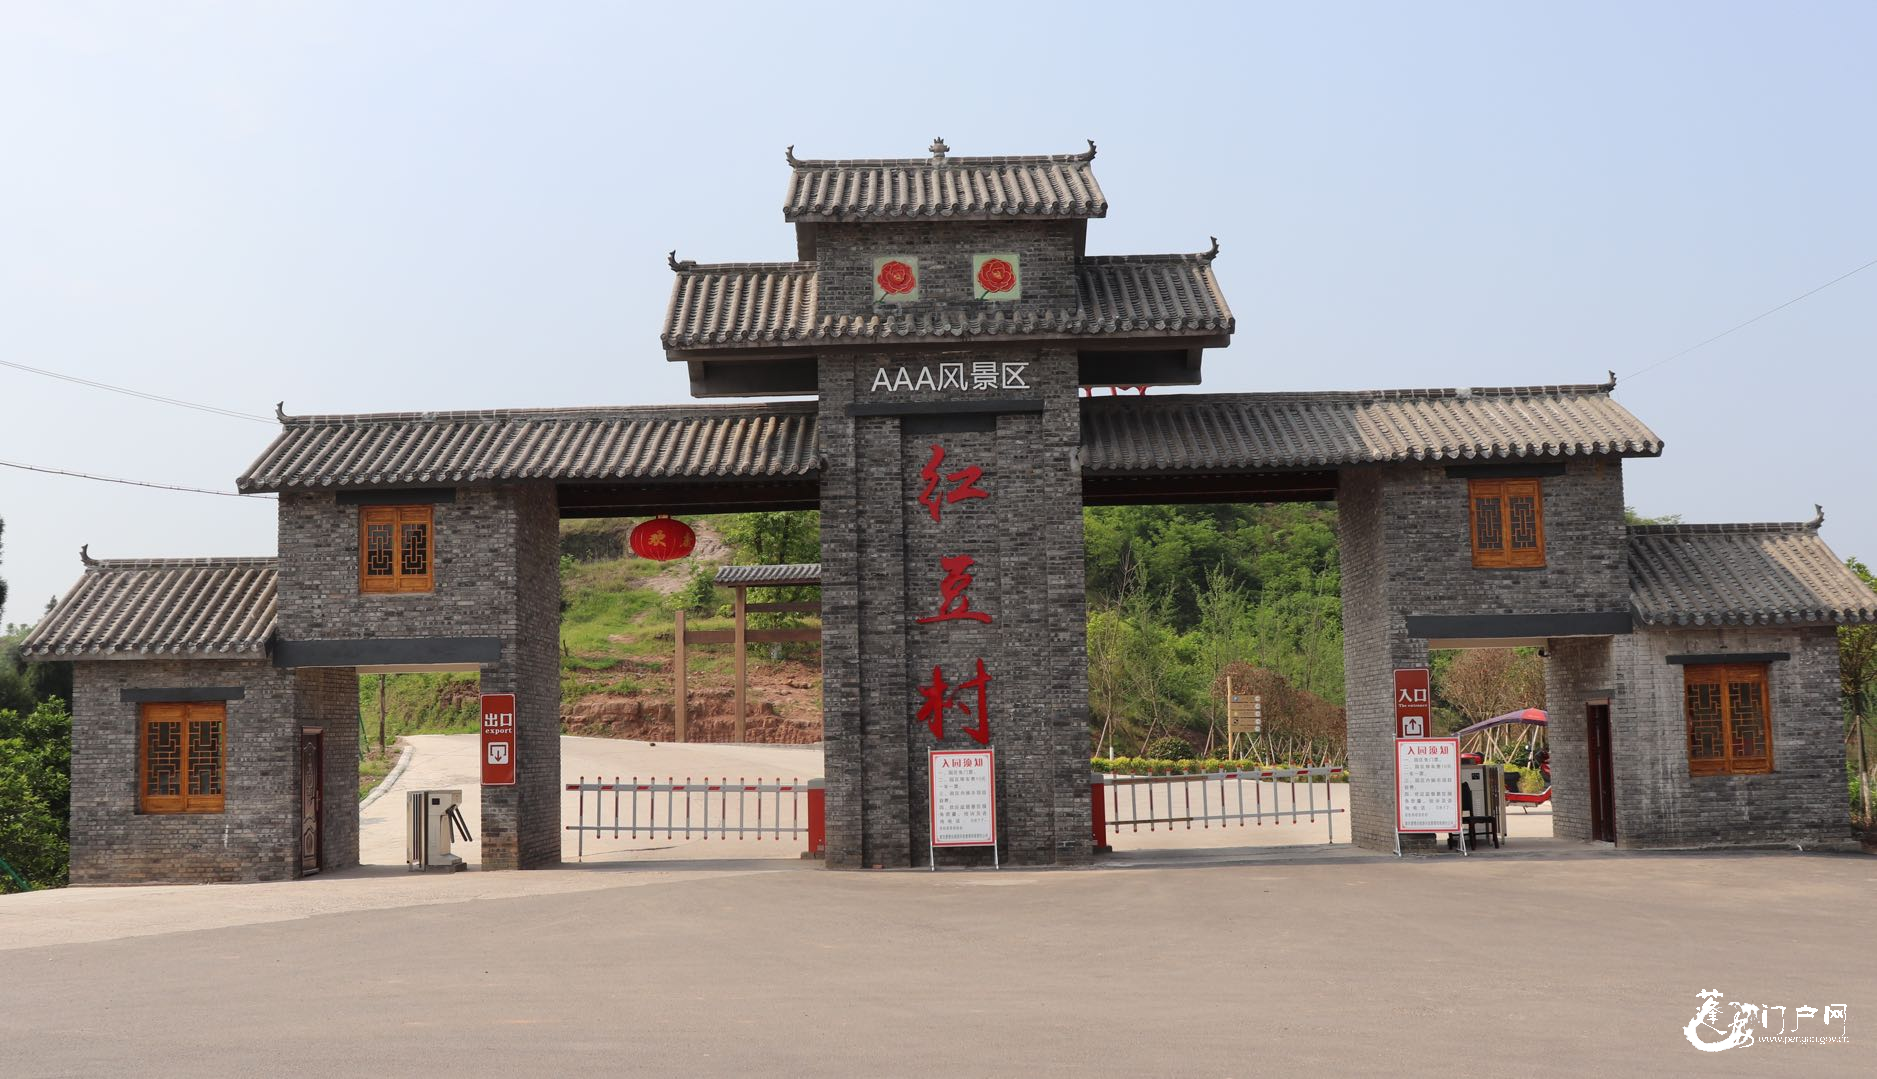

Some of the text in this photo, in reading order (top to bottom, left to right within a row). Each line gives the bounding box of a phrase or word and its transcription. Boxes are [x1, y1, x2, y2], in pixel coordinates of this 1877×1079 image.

[870, 361, 1031, 392] AAA风景区
[1398, 688, 1427, 703] 入口
[485, 713, 512, 727] 出口
